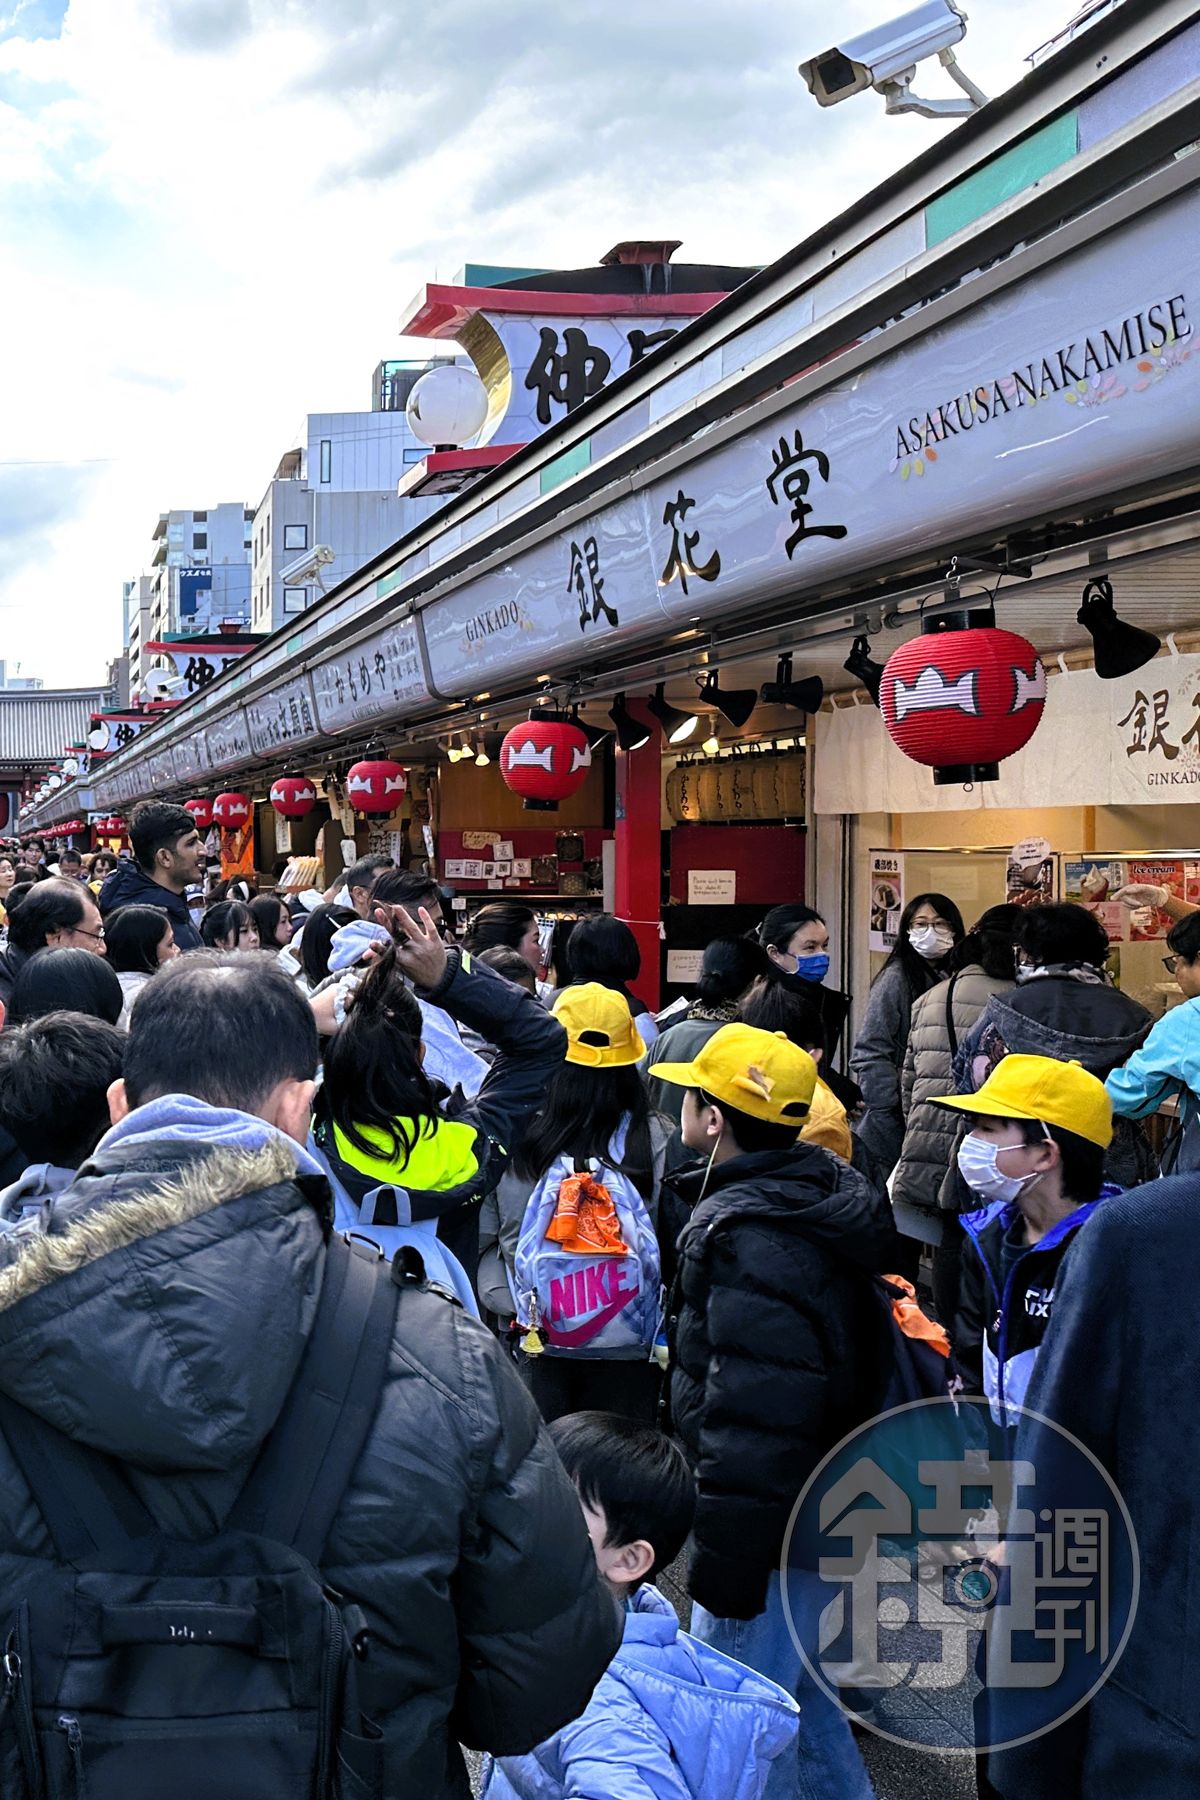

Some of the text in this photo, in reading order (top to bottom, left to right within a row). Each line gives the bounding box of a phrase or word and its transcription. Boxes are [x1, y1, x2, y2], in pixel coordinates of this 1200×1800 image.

[896, 294, 1191, 460] ASAKUSA NAKAMISE
[566, 429, 848, 633] 銀花堂
[465, 600, 519, 642] GINKADO
[335, 650, 386, 704] かもめや
[549, 1258, 628, 1322] NIKE
